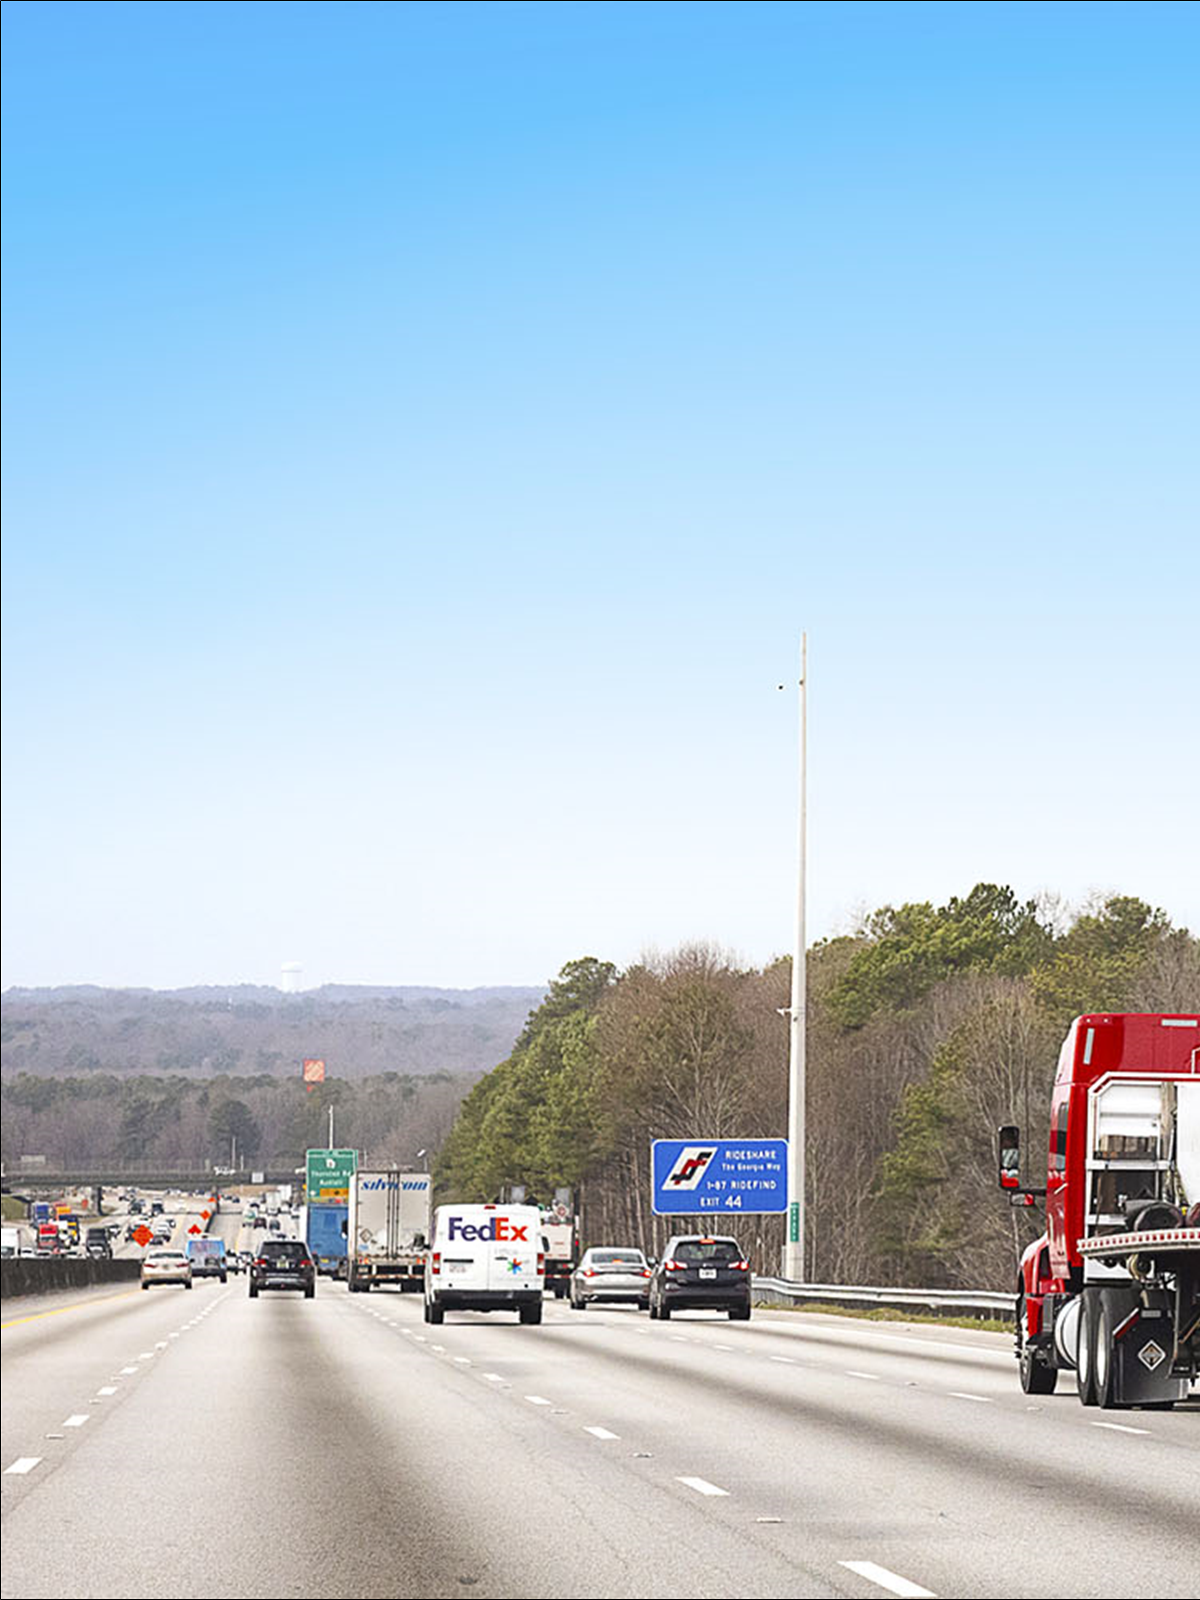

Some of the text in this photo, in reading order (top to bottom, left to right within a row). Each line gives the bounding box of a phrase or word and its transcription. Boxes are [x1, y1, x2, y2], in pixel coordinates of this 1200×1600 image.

[725, 1150, 776, 1159] RIDESHARE
[722, 1163, 734, 1171] The
[737, 1163, 764, 1172] Georgia
[731, 1180, 776, 1190] RIDEFIND
[700, 1195, 742, 1208] EXIT 44
[448, 1217, 528, 1241] FedEx
